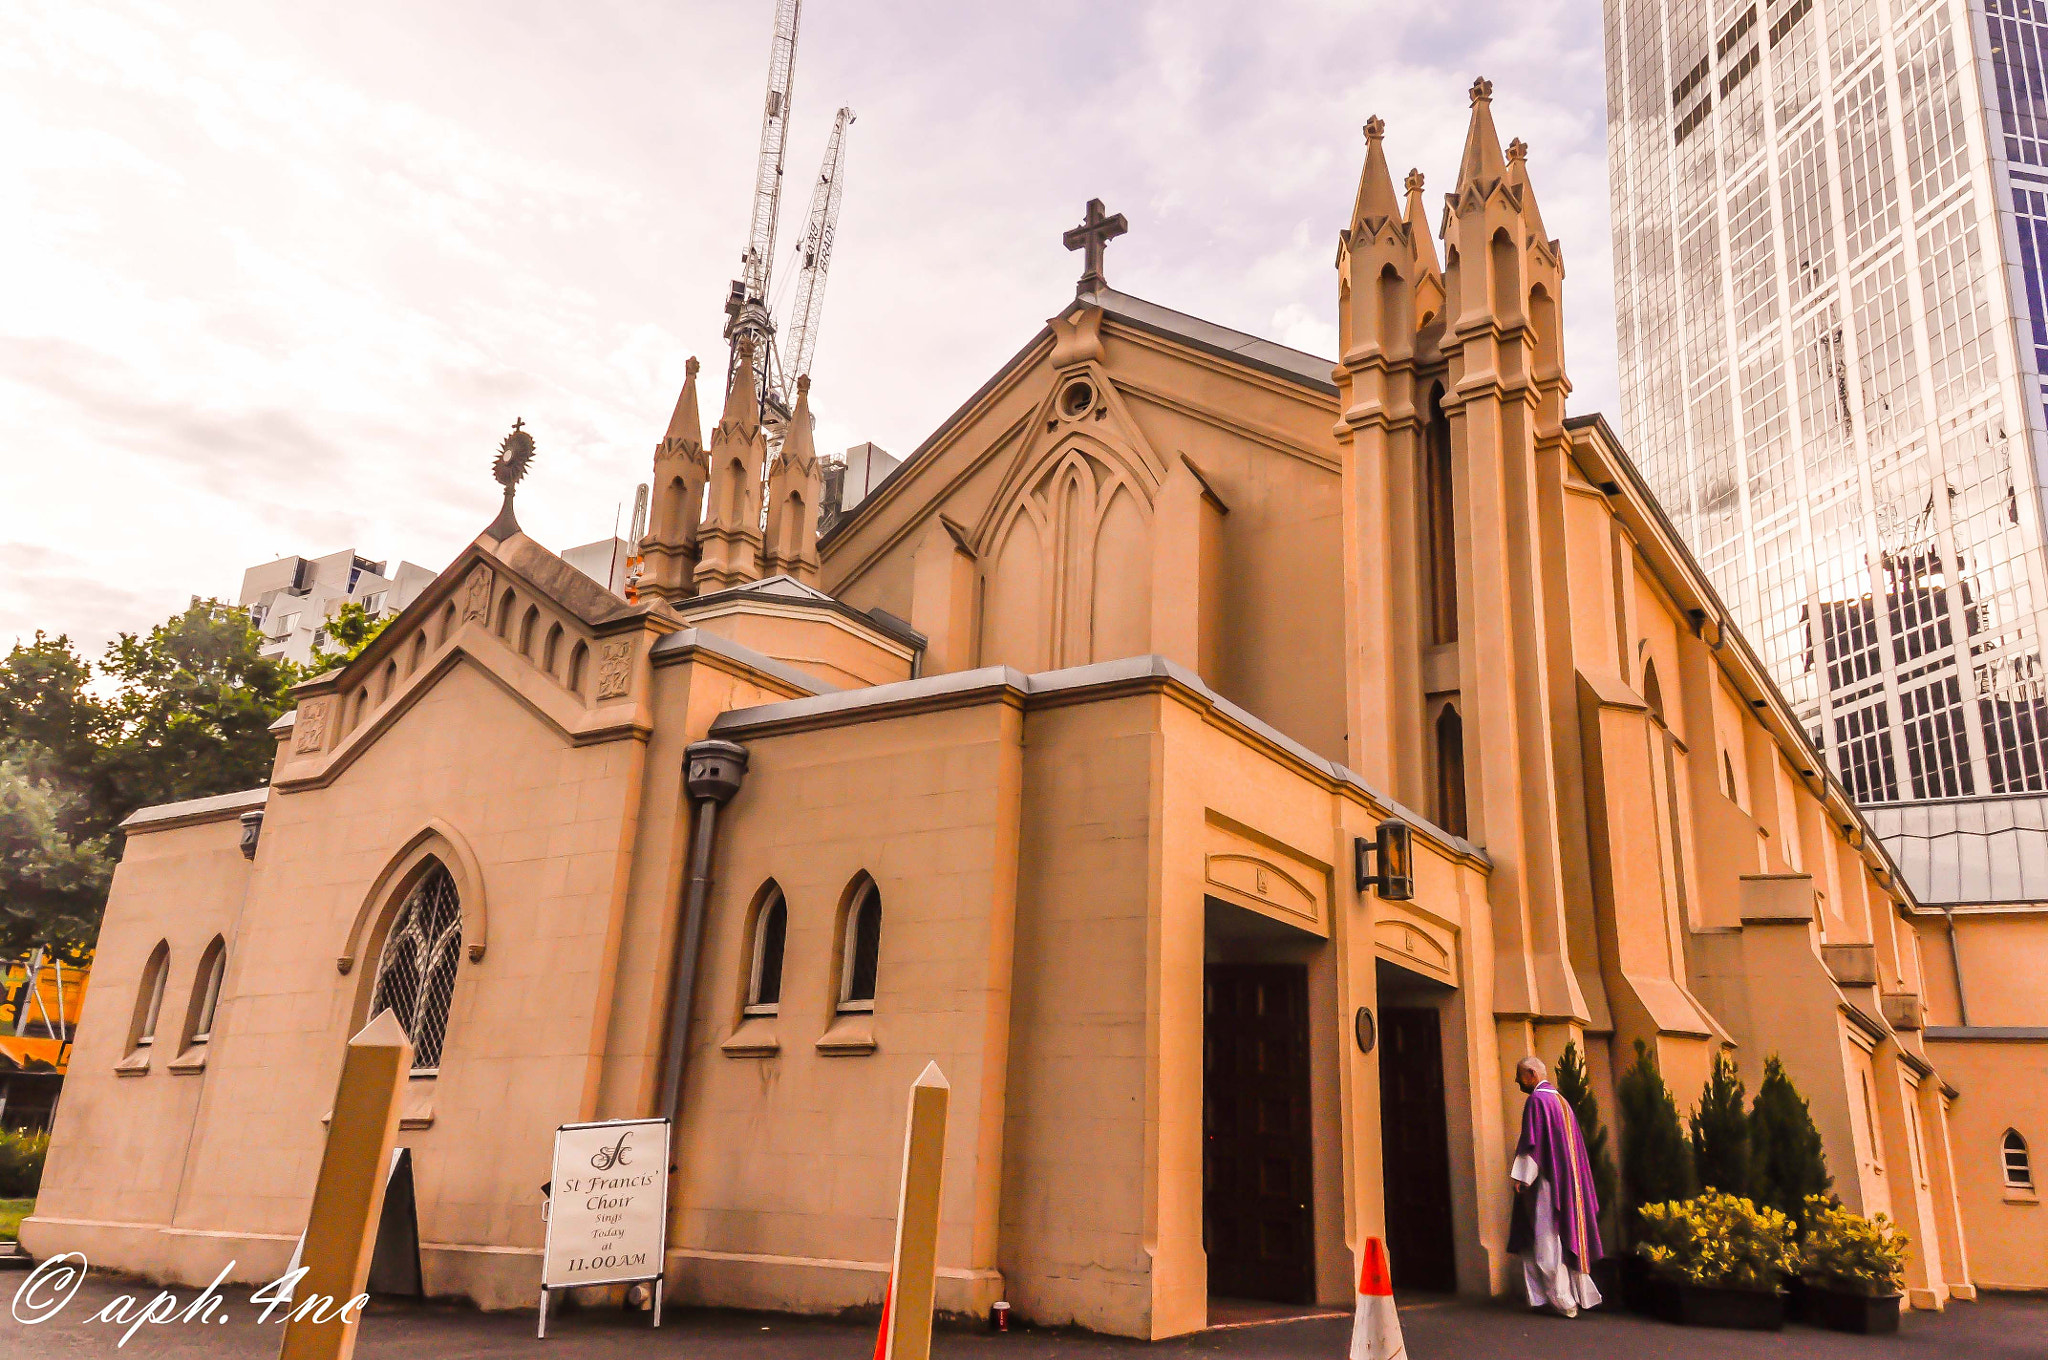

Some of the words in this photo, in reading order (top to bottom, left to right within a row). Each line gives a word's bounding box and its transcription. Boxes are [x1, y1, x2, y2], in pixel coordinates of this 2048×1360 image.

[820, 217, 834, 273] BRADY
[563, 1179, 580, 1193] St
[586, 1194, 634, 1210] Choir
[592, 1228, 625, 1239] Today
[601, 1242, 612, 1251] at
